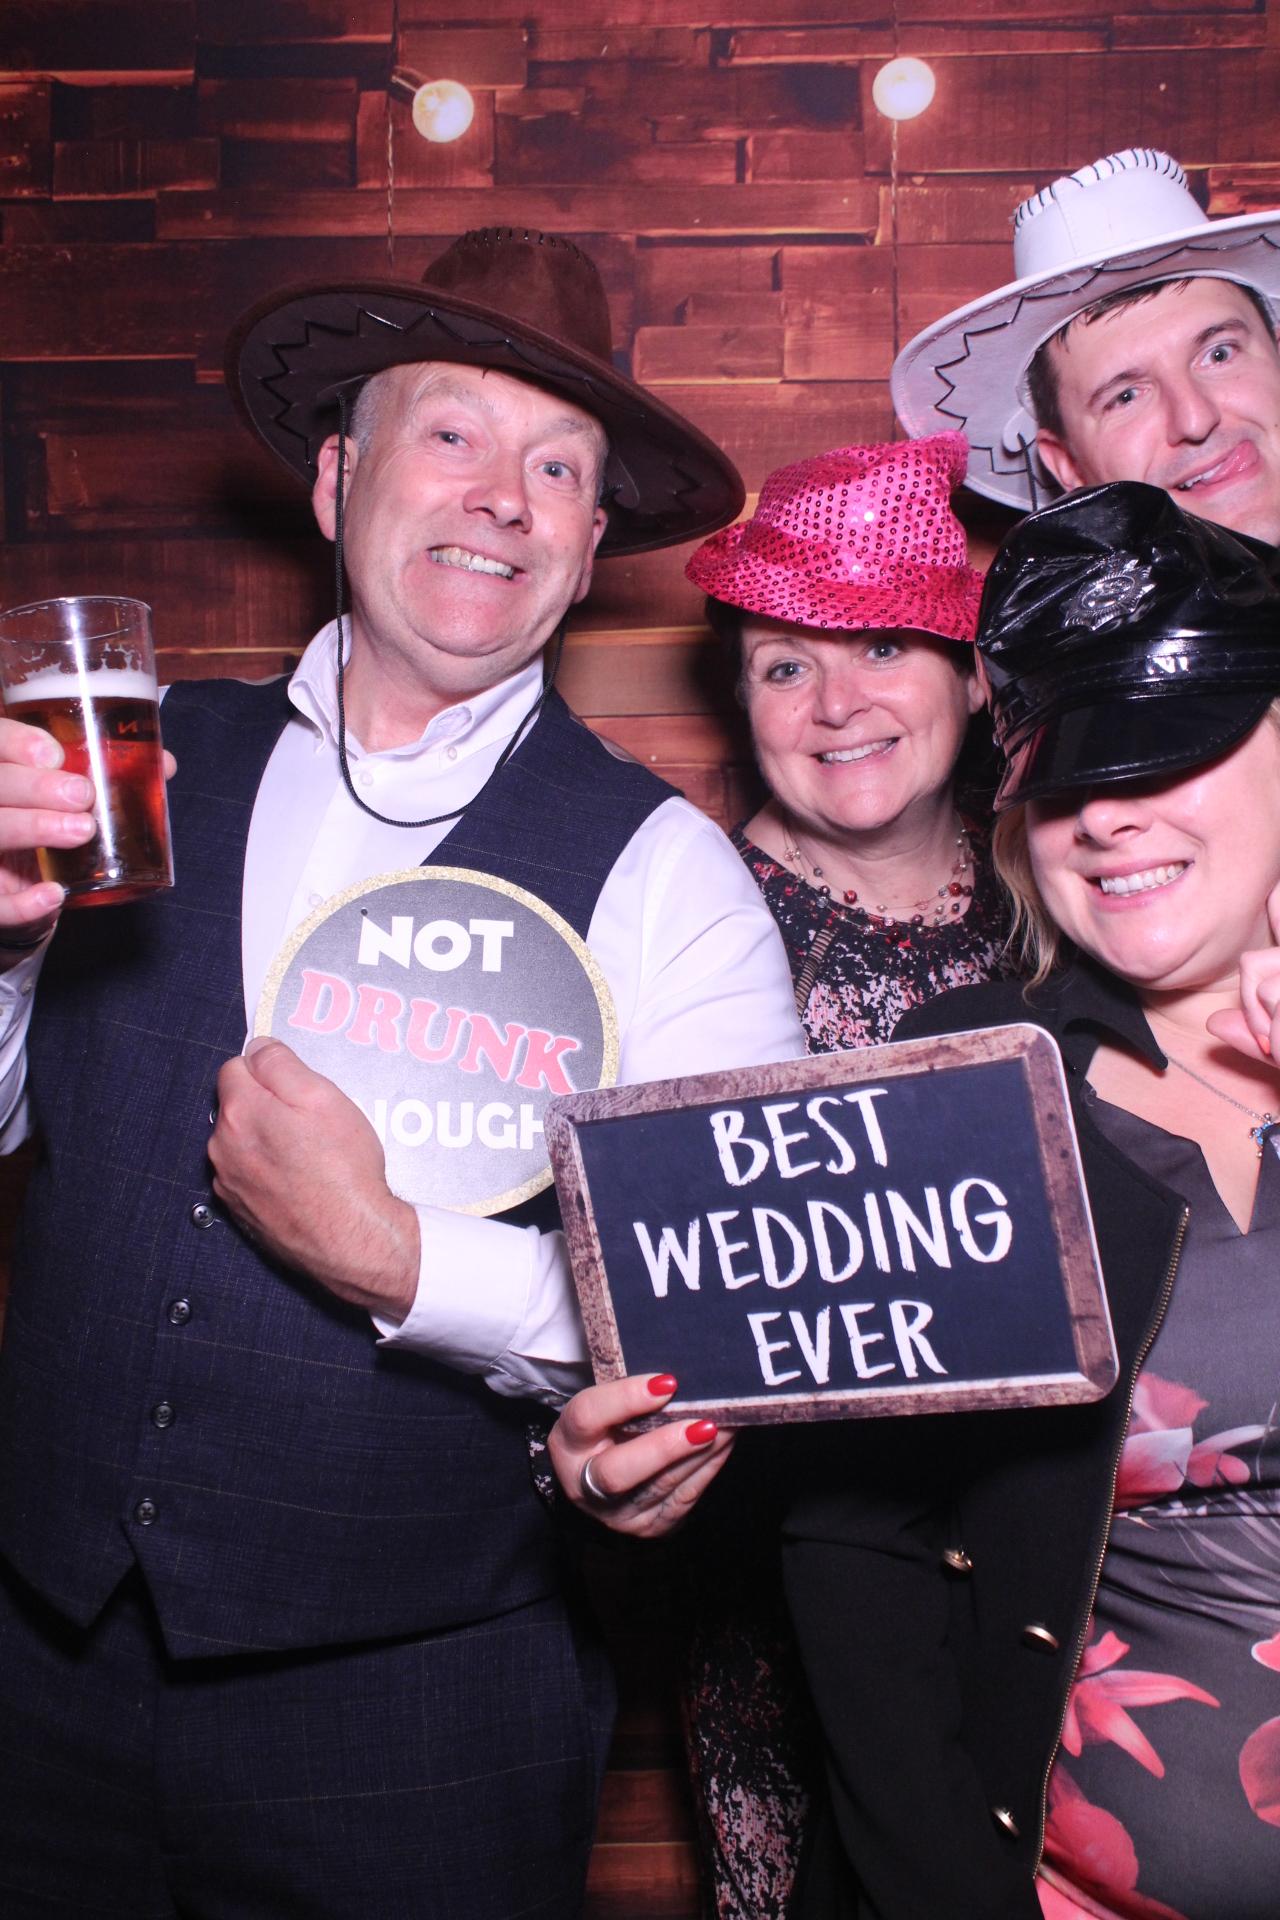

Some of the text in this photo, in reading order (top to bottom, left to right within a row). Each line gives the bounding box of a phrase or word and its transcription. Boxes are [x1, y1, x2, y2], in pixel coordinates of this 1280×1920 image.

[357, 915, 514, 972] NOT
[287, 970, 582, 1096] DRUNK
[355, 1098, 545, 1150] OUGH
[709, 1088, 888, 1187] BEST
[632, 1178, 1013, 1298] WEDDING
[746, 1300, 949, 1386] EVER
